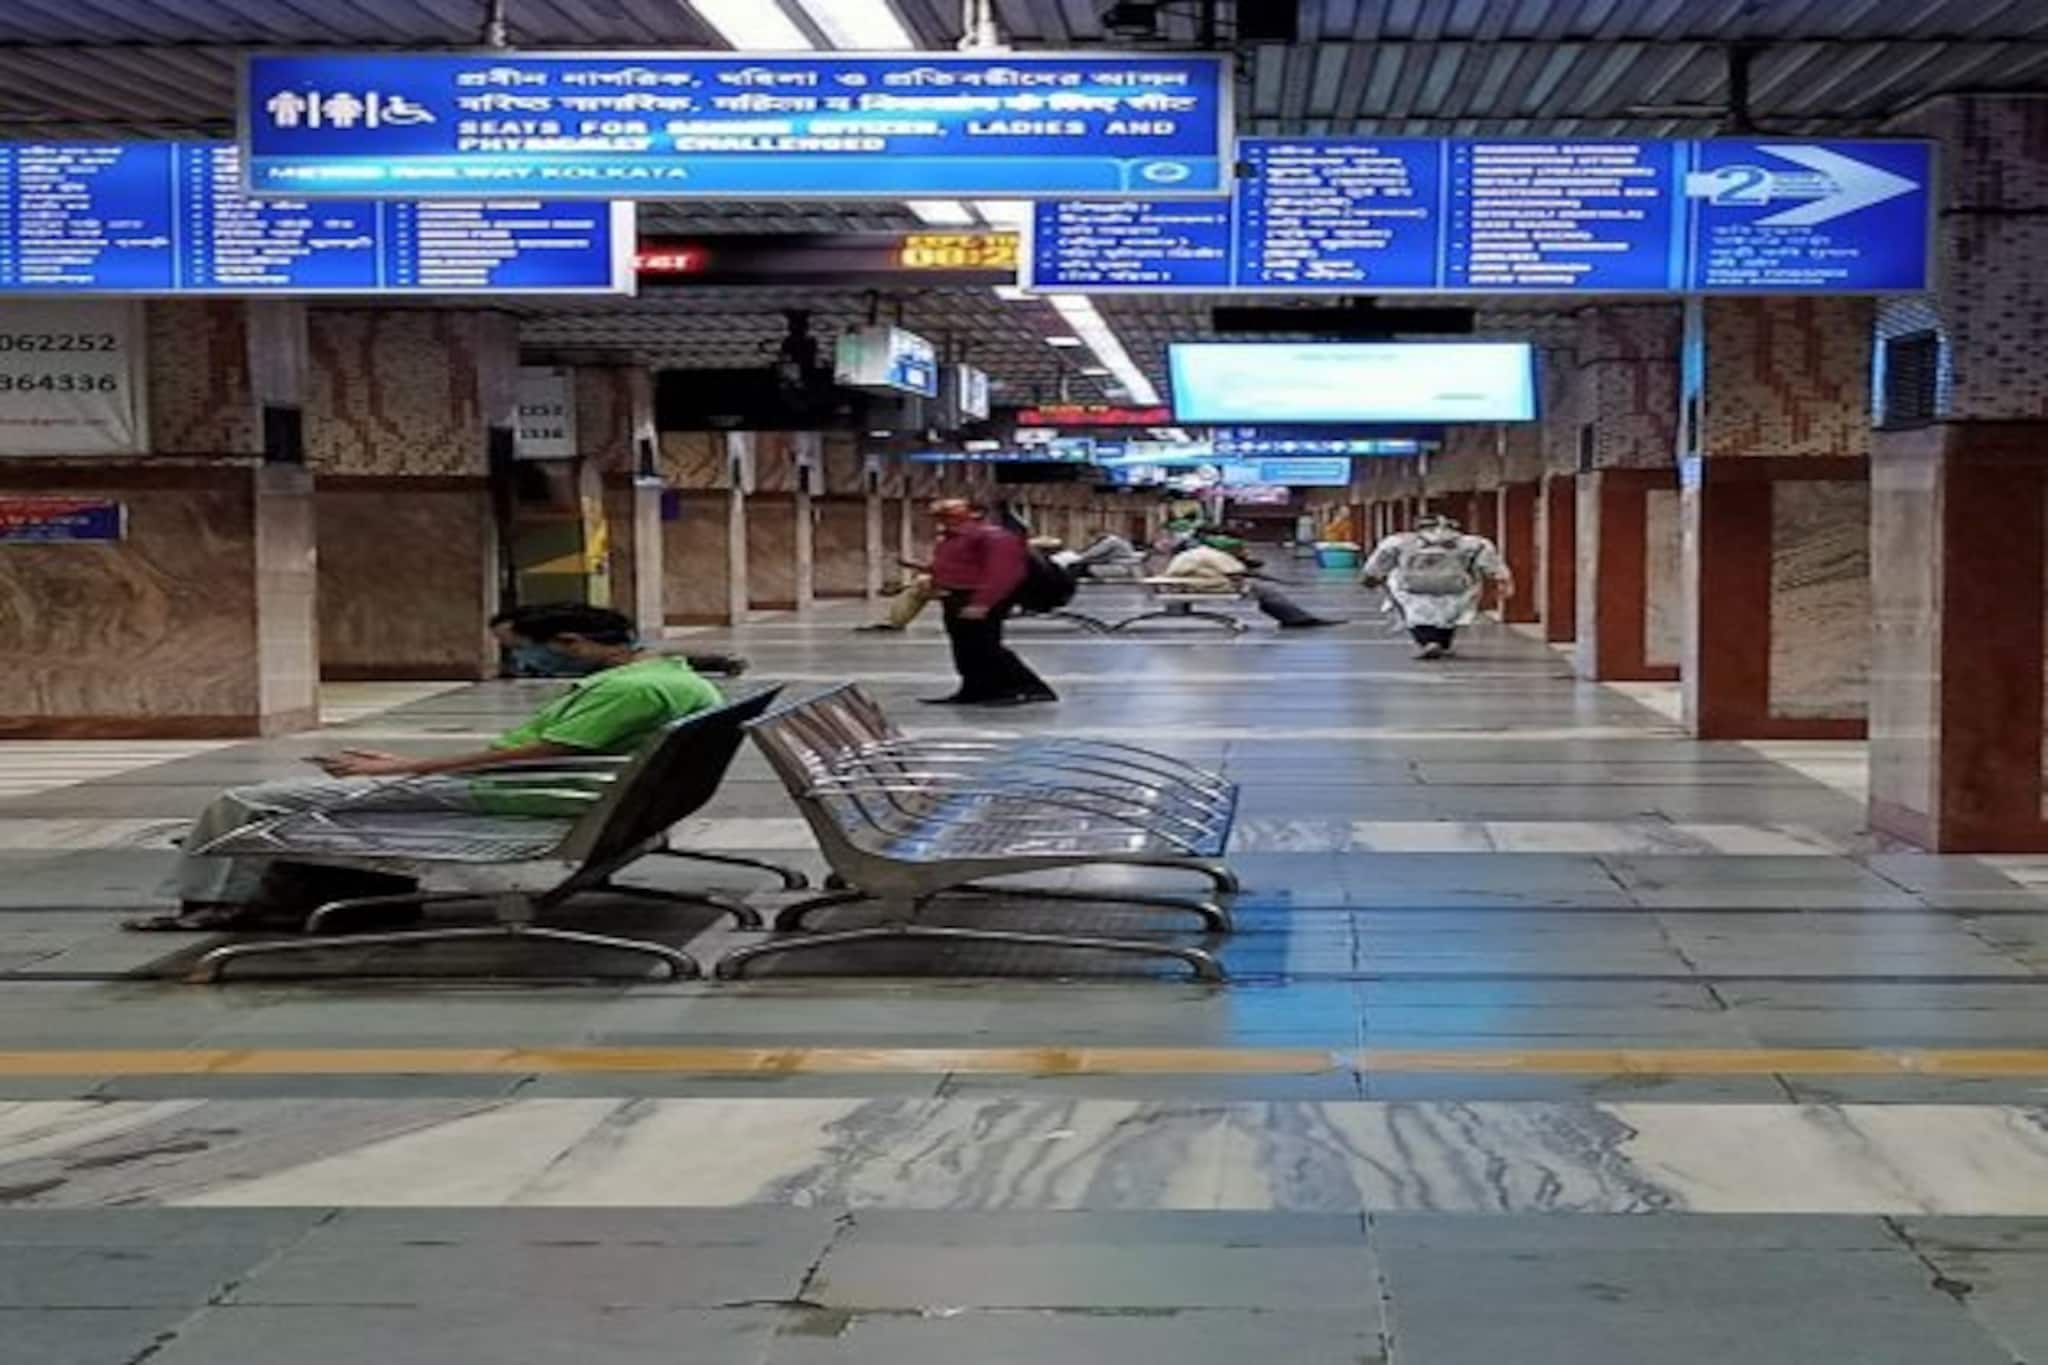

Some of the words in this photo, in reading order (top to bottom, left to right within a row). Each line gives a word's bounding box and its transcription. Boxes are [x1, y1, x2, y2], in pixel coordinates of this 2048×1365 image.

[459, 120, 560, 135] SEATS
[582, 120, 647, 135] FOR
[967, 120, 1086, 135] LADIES
[1106, 120, 1176, 135] AND
[542, 167, 688, 179] KOLKATA
[1712, 166, 1767, 205] 2
